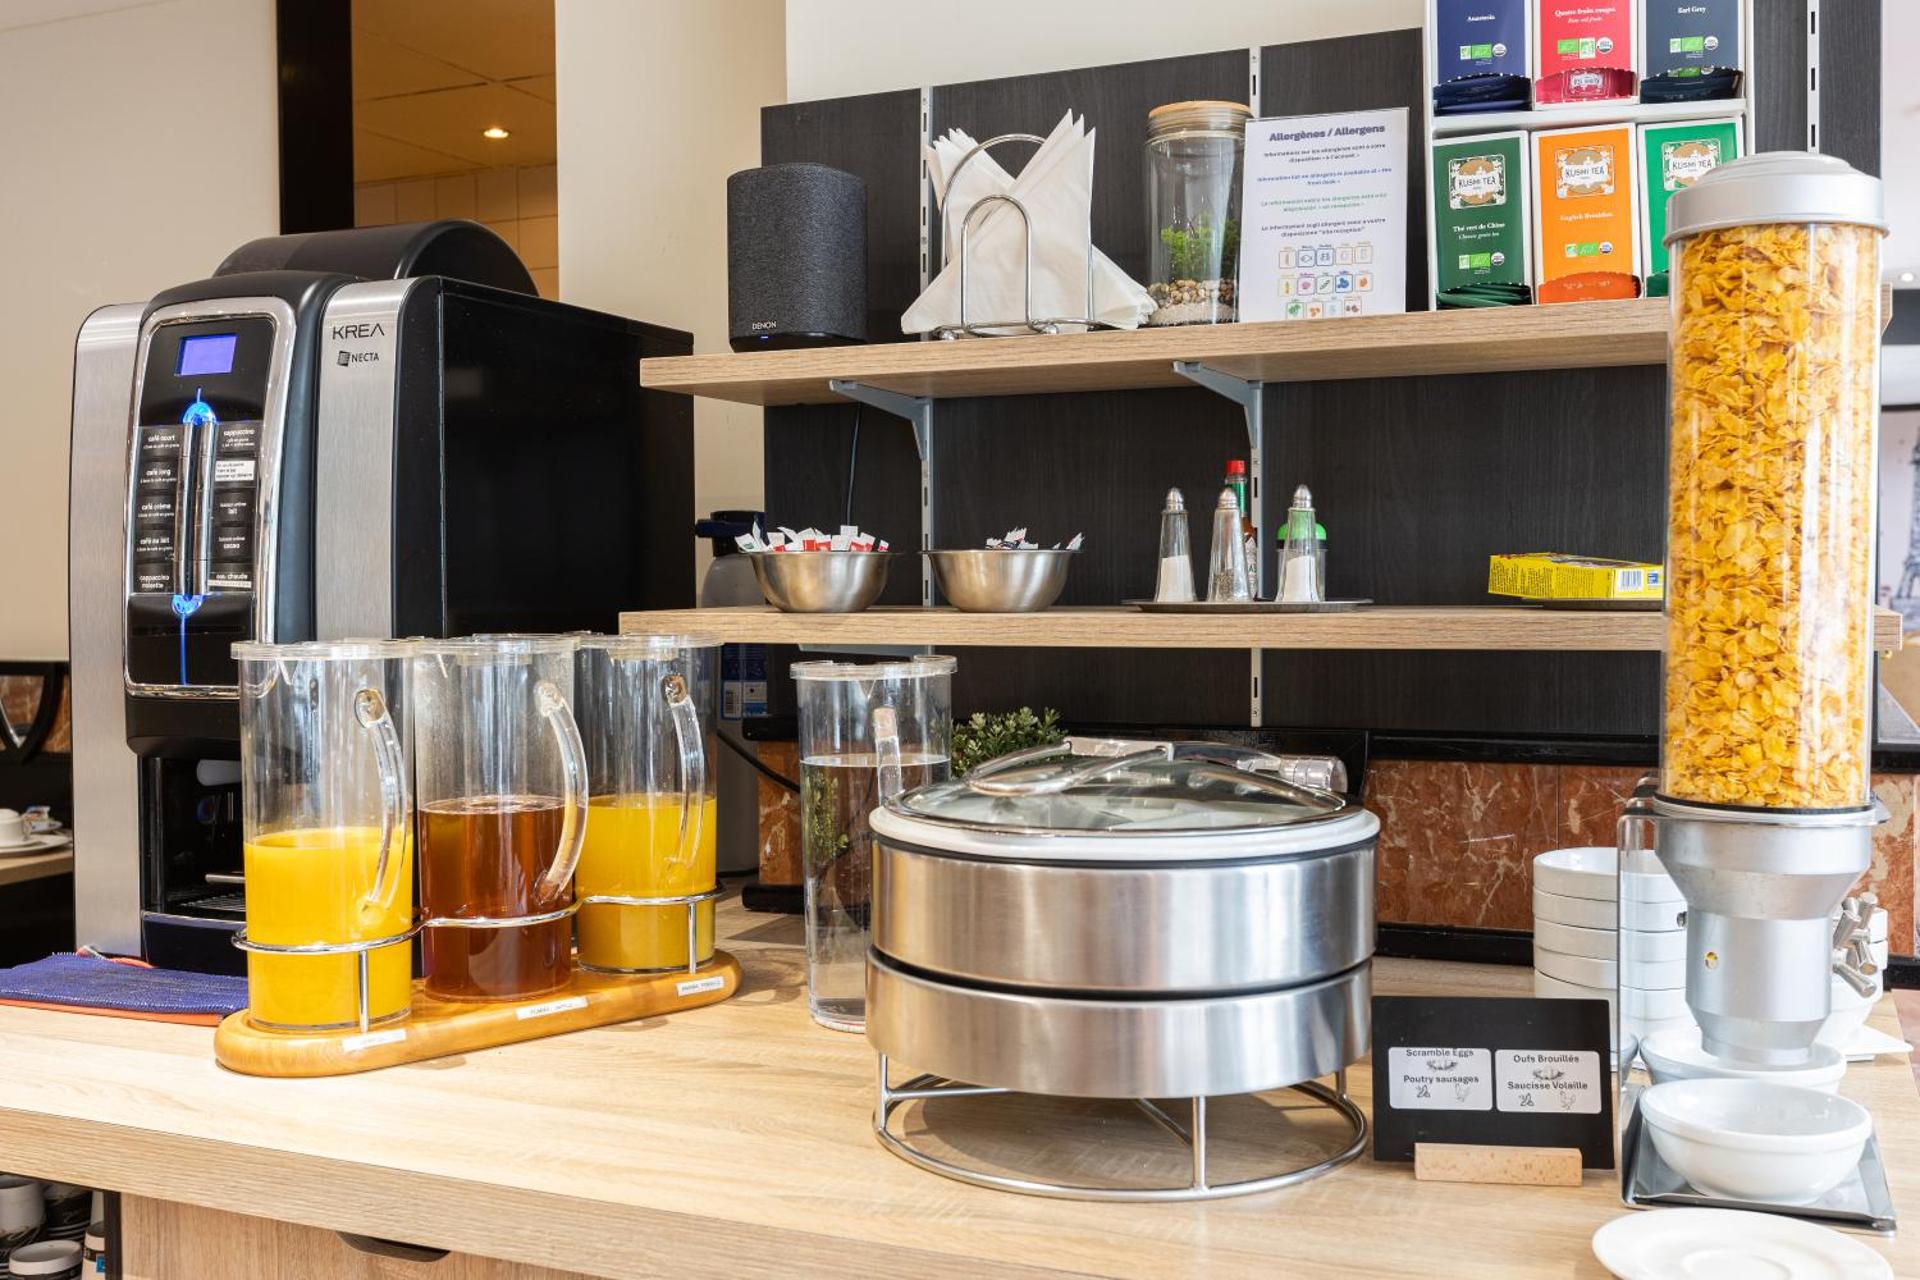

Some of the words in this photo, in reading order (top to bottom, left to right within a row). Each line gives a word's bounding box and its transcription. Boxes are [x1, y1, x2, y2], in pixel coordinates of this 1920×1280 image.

[1692, 6, 1706, 14] Grey
[1269, 130, 1325, 142] Allergènes
[1334, 125, 1385, 137] Allergens
[1698, 159, 1712, 168] TEA
[1591, 166, 1605, 175] TEA
[1482, 177, 1496, 185] TEA
[1452, 224, 1465, 232] Thé
[752, 320, 777, 330] DENON
[332, 322, 385, 340] KREA
[351, 352, 380, 363] NECTA
[1406, 1048, 1451, 1057] Scramble
[1537, 1054, 1579, 1063] Brouillés
[1403, 1074, 1433, 1084] Poutry
[1435, 1075, 1479, 1085] sausages
[1507, 1081, 1551, 1090] Saucisse
[1552, 1081, 1588, 1090] Volaille
